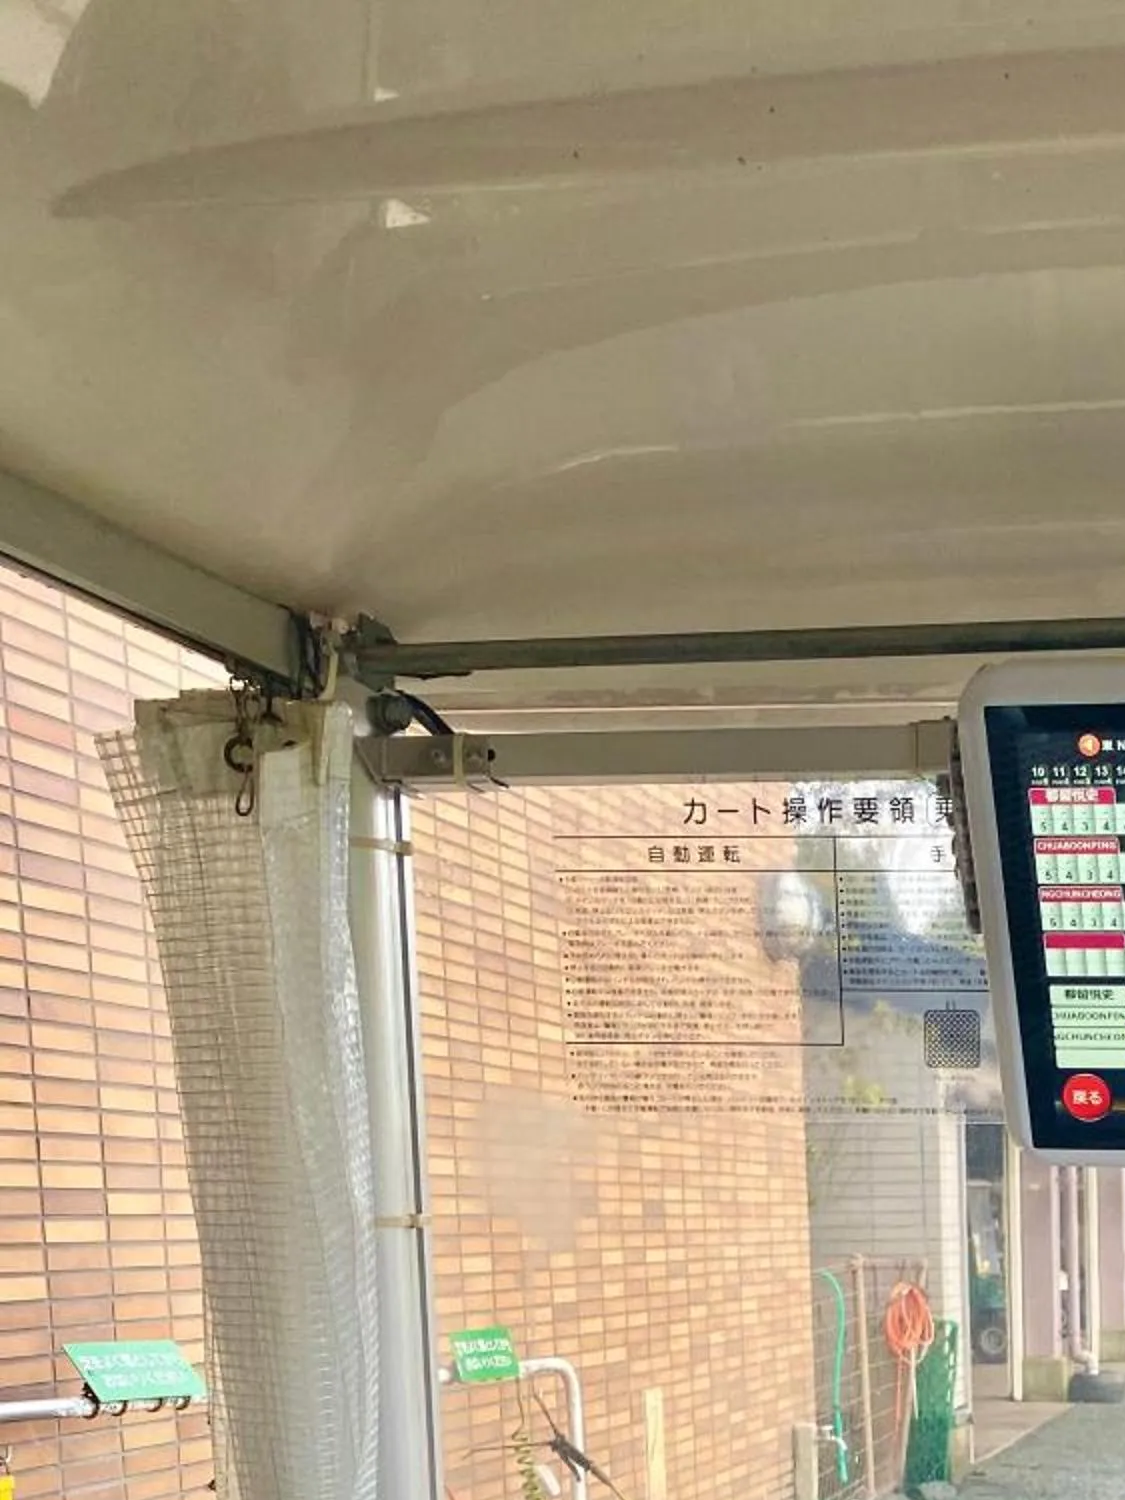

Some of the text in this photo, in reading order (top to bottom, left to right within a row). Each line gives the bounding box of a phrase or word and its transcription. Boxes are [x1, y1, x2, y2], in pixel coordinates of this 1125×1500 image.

[1032, 765, 1045, 776] 10
[1053, 765, 1065, 776] 11
[1074, 765, 1087, 776] 12
[1095, 765, 1108, 776] 13
[648, 845, 741, 864] 自動運転
[1072, 1089, 1103, 1105] 戻る
